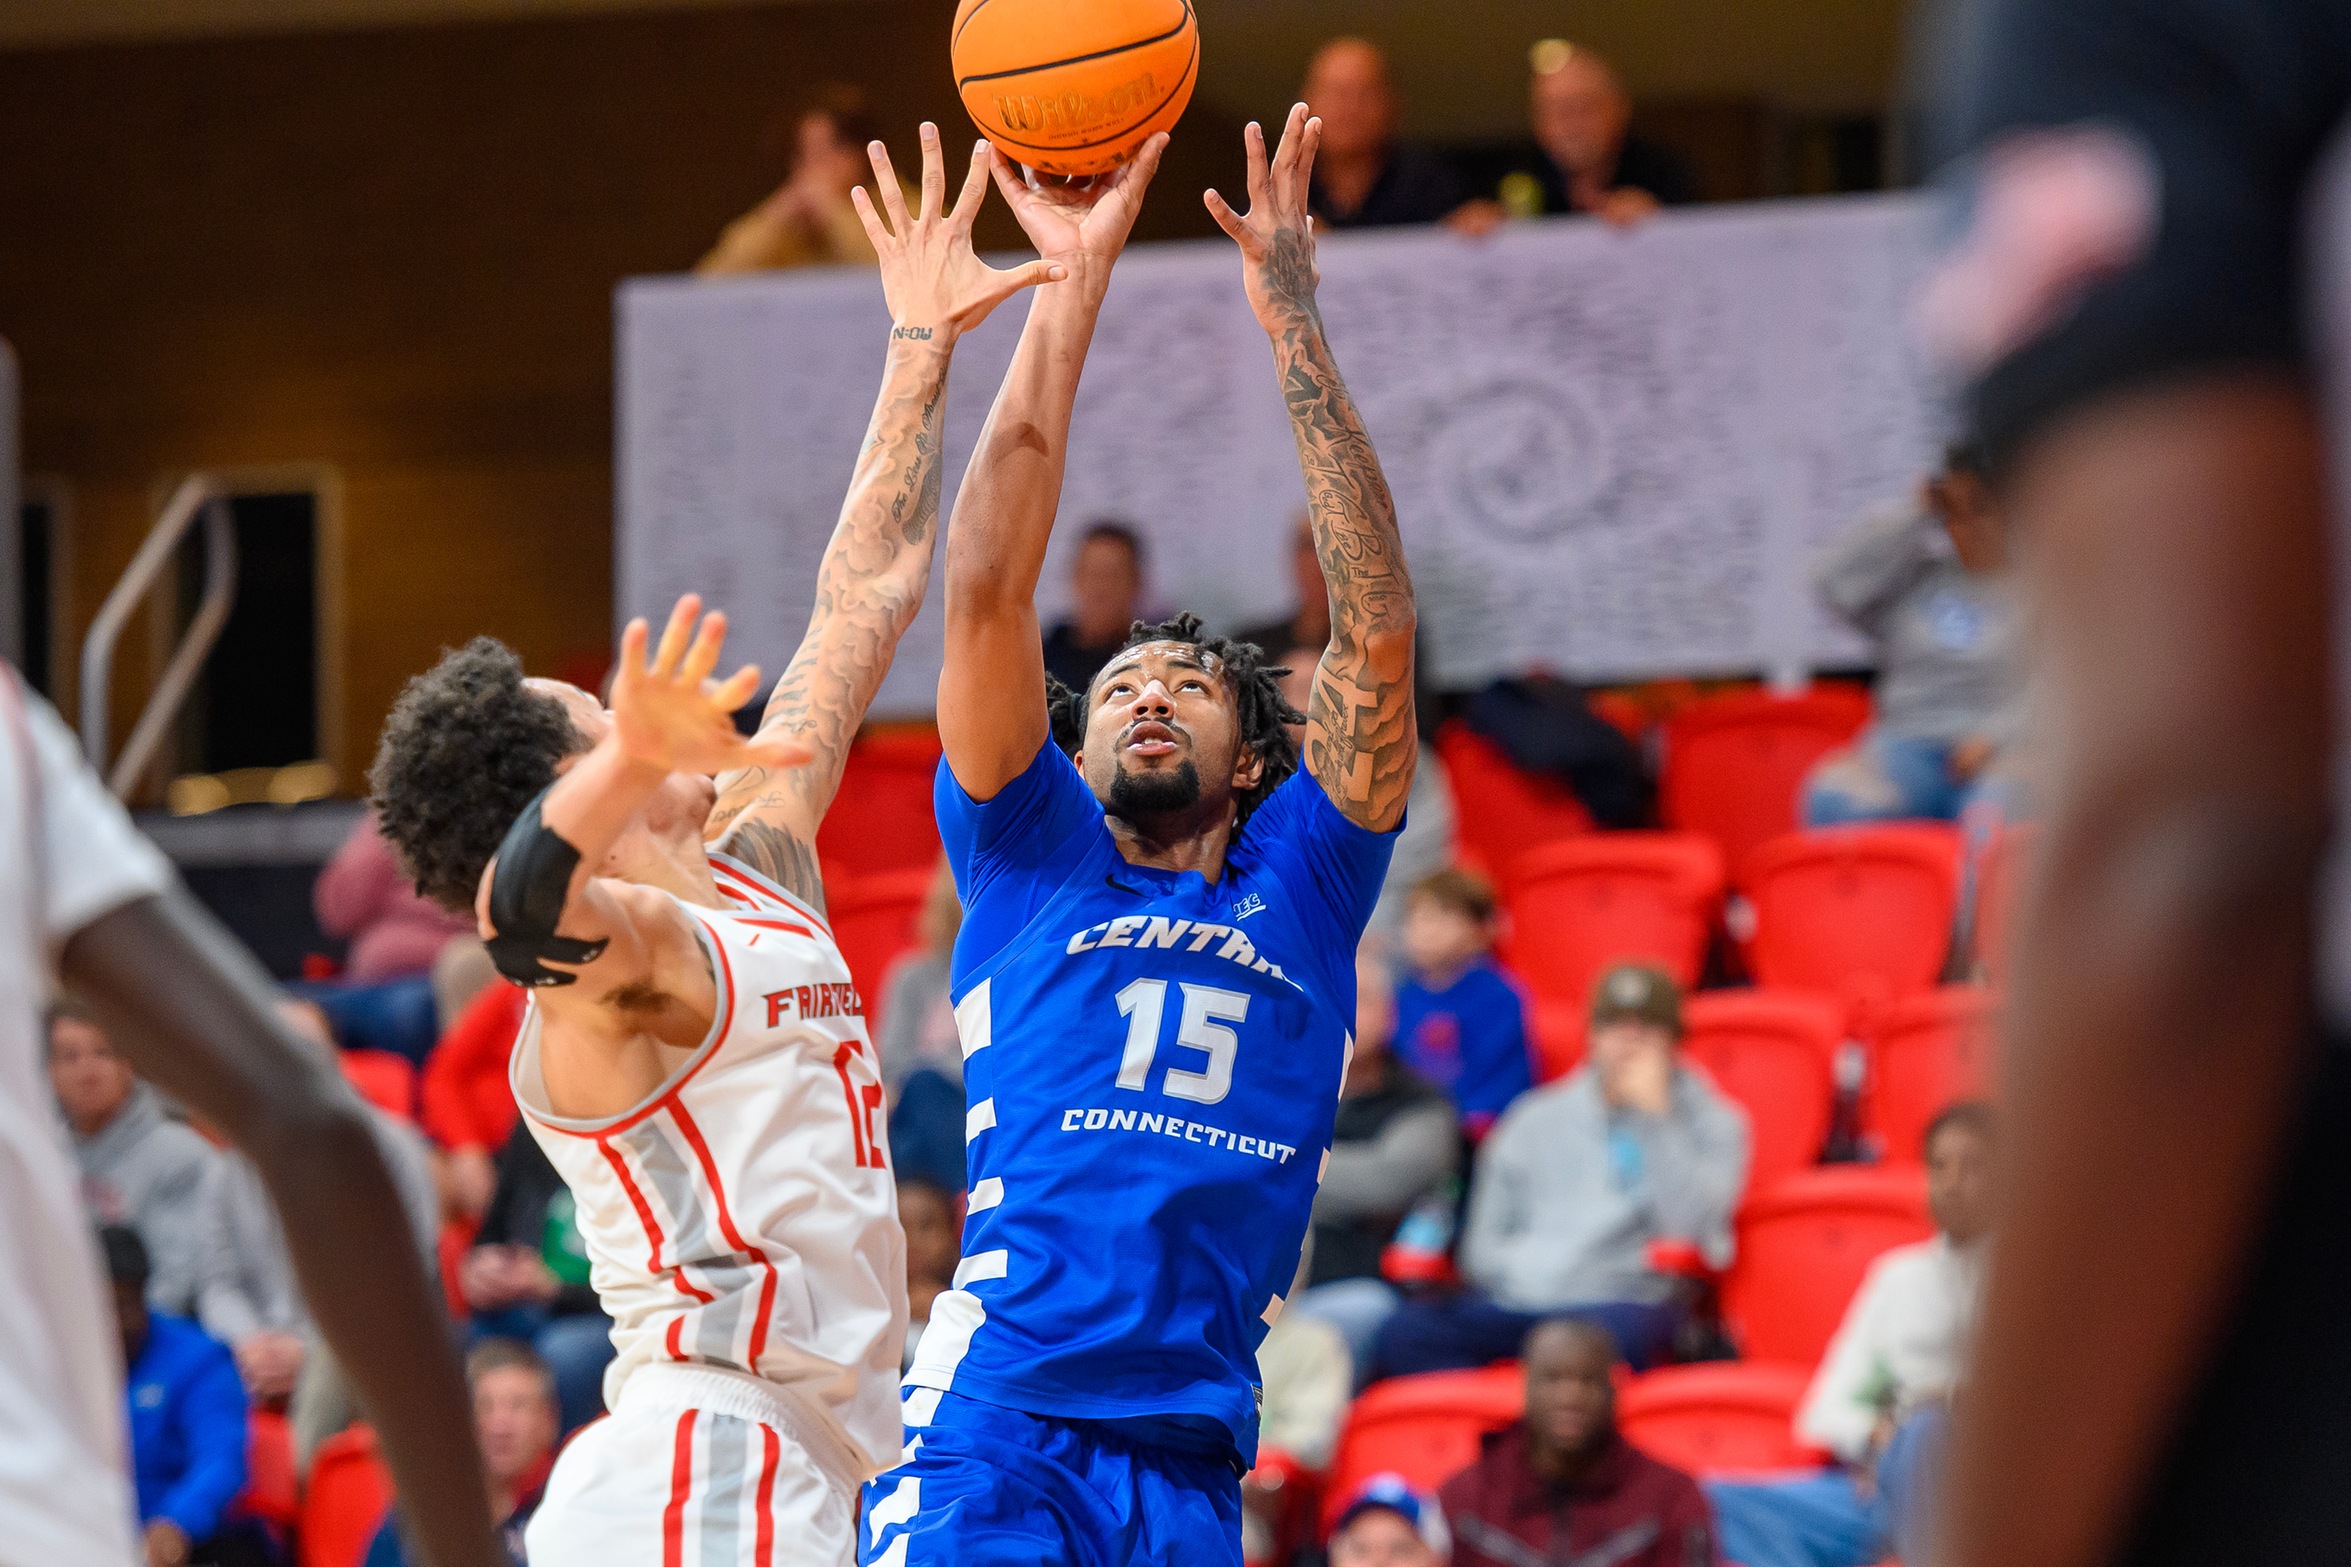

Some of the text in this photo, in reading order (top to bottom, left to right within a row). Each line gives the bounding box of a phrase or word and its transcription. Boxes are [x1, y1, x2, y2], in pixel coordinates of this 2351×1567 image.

[1066, 915, 1304, 993] CENTR
[761, 982, 863, 1028] FAIRFIEL
[1115, 977, 1251, 1105] 15
[1061, 1108, 1296, 1165] CONNECTICUT
